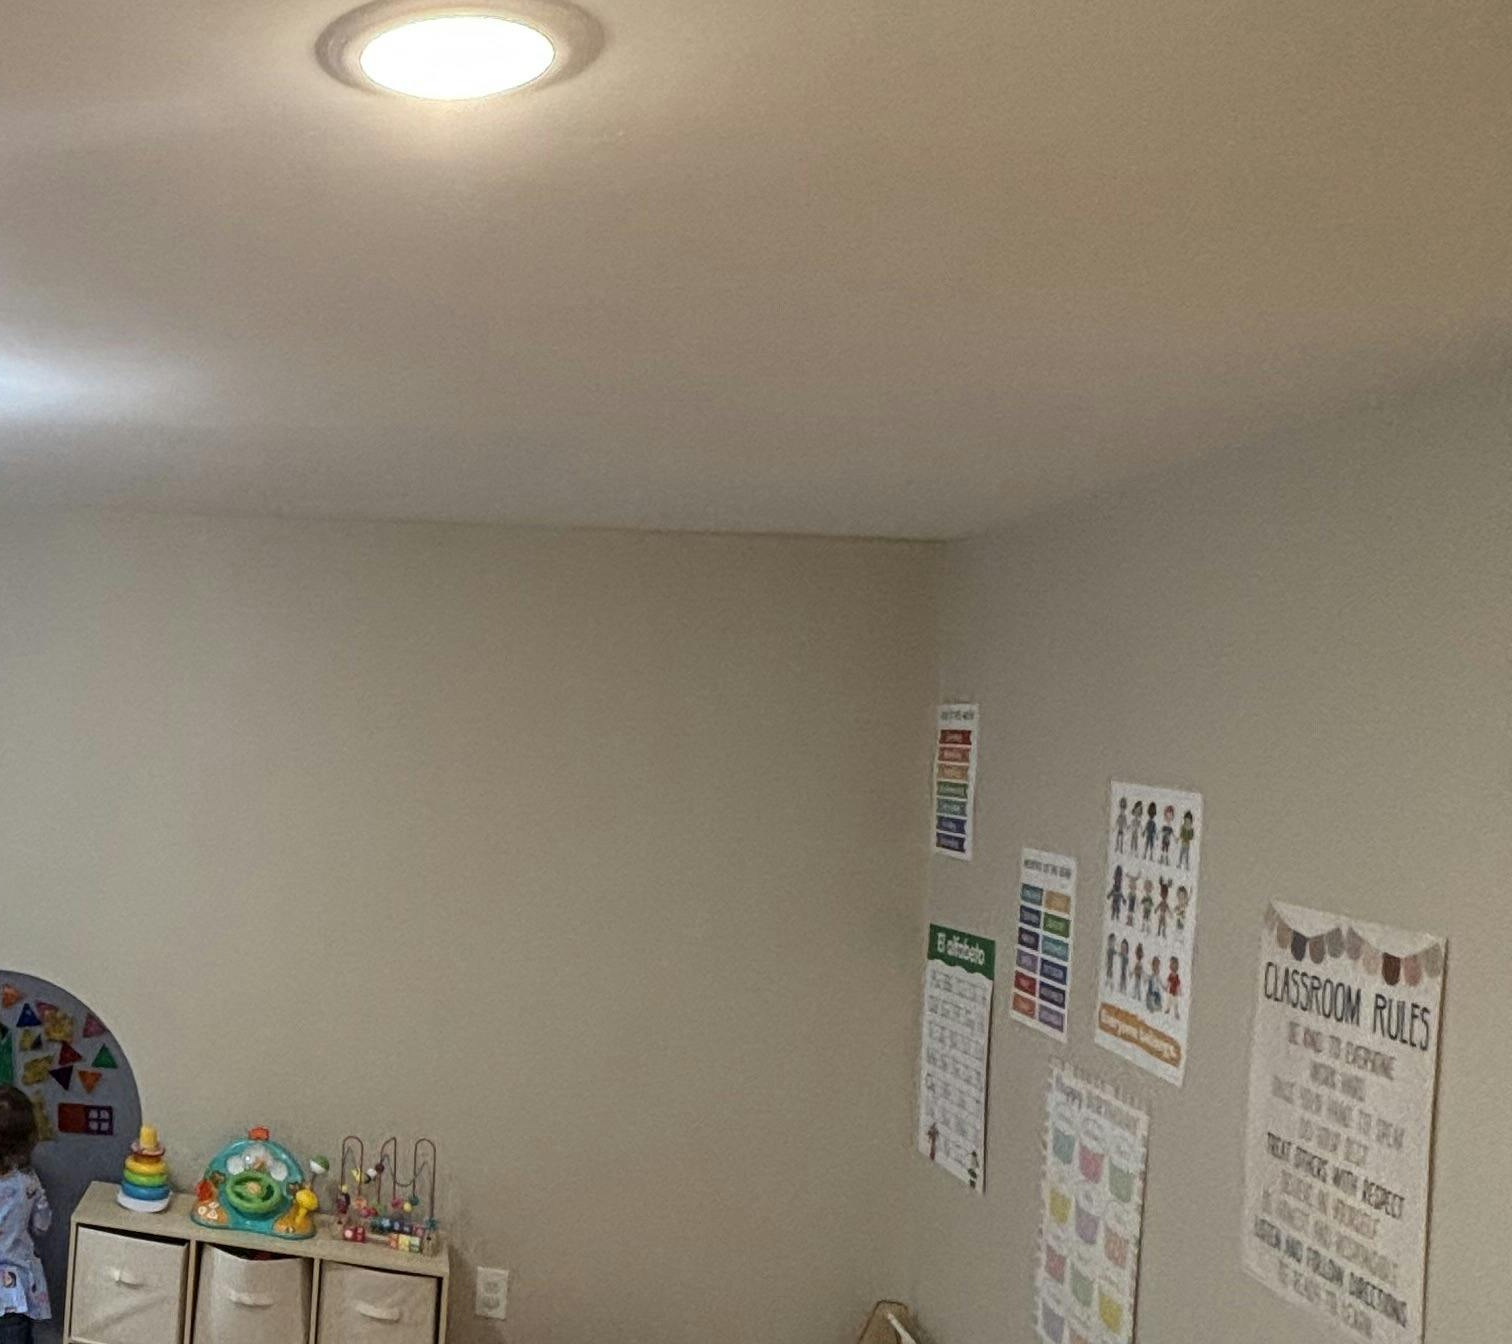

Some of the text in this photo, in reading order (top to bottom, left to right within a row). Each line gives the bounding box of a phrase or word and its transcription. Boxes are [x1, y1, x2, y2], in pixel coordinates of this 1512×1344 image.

[935, 931, 986, 967] El alfabeto
[1263, 960, 1431, 1052] CLASSROOM RULES
